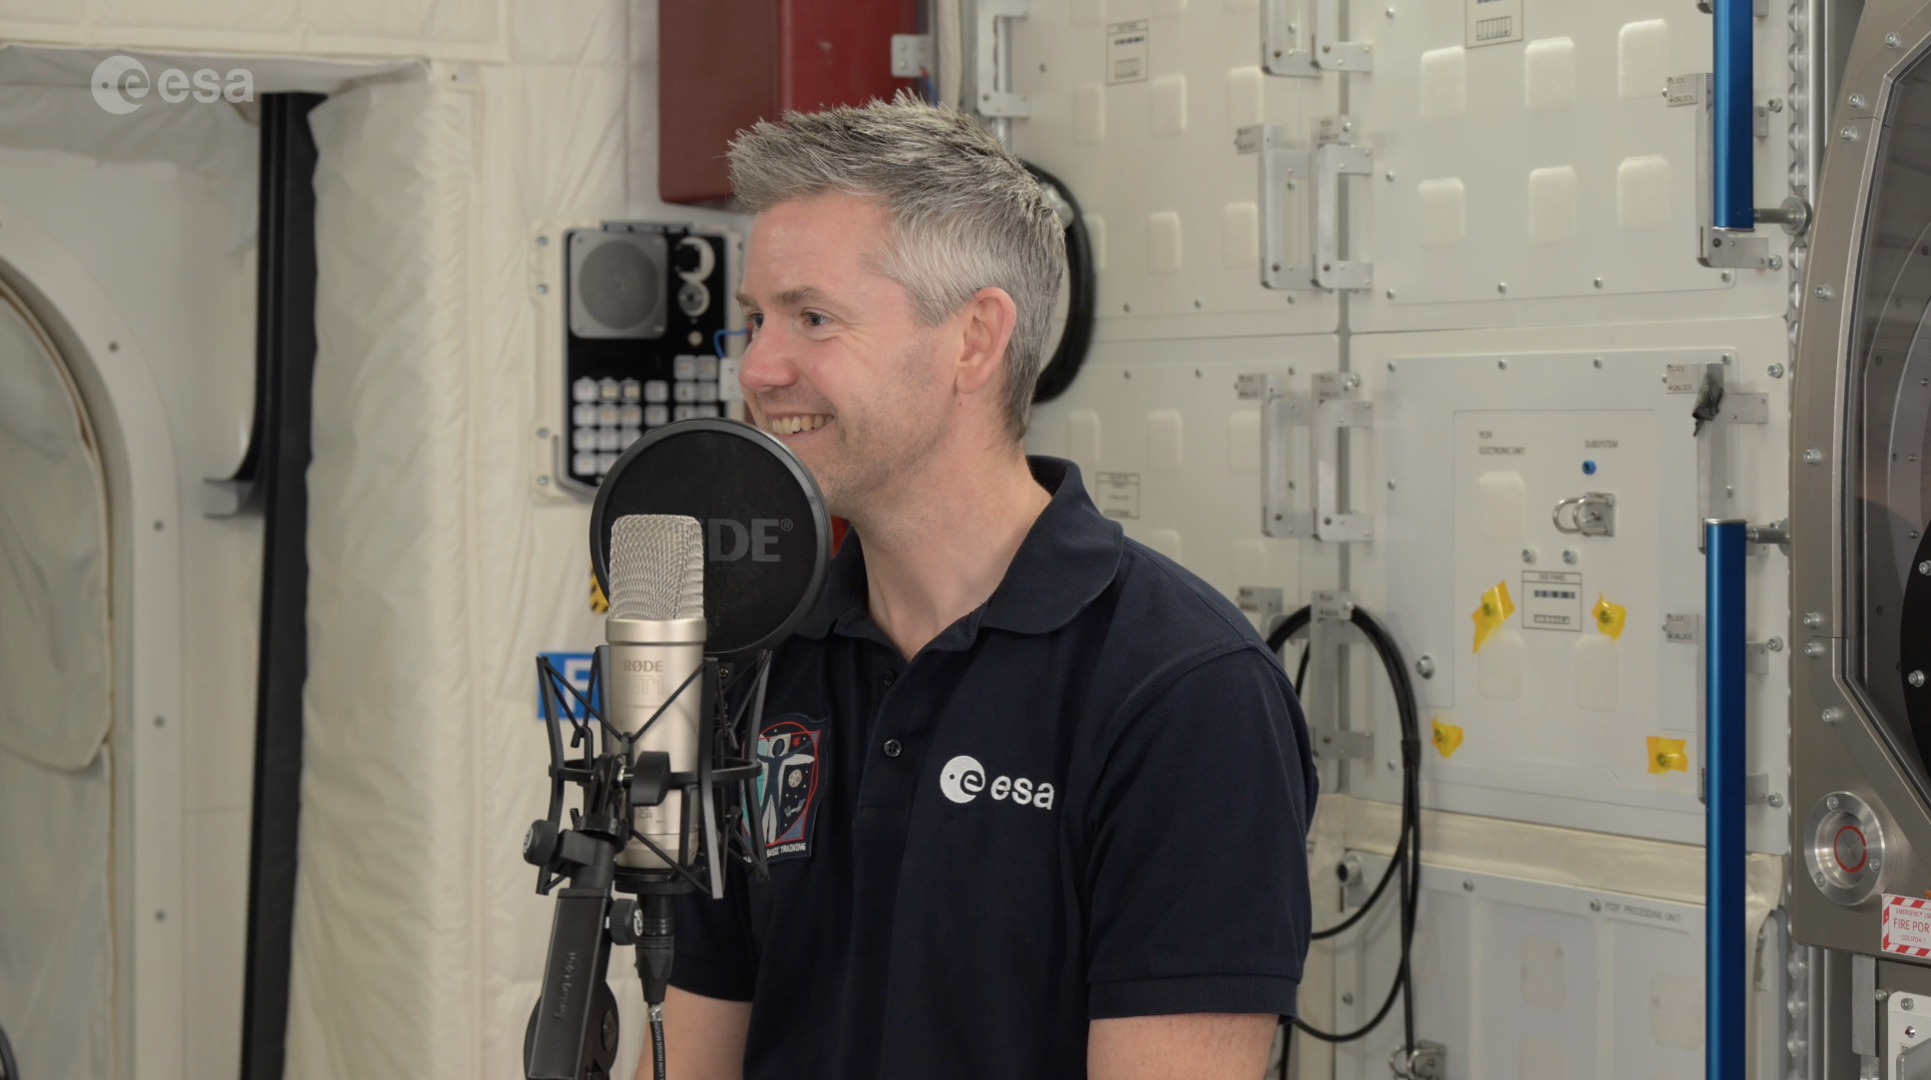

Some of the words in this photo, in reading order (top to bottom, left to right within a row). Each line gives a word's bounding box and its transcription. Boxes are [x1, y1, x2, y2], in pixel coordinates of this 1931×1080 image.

[623, 660, 663, 672] RØDE
[990, 775, 1055, 810] esa
[780, 842, 806, 854] TRAINING
[1895, 908, 1923, 917] EMERGENCY
[1893, 917, 1910, 930] FIRE
